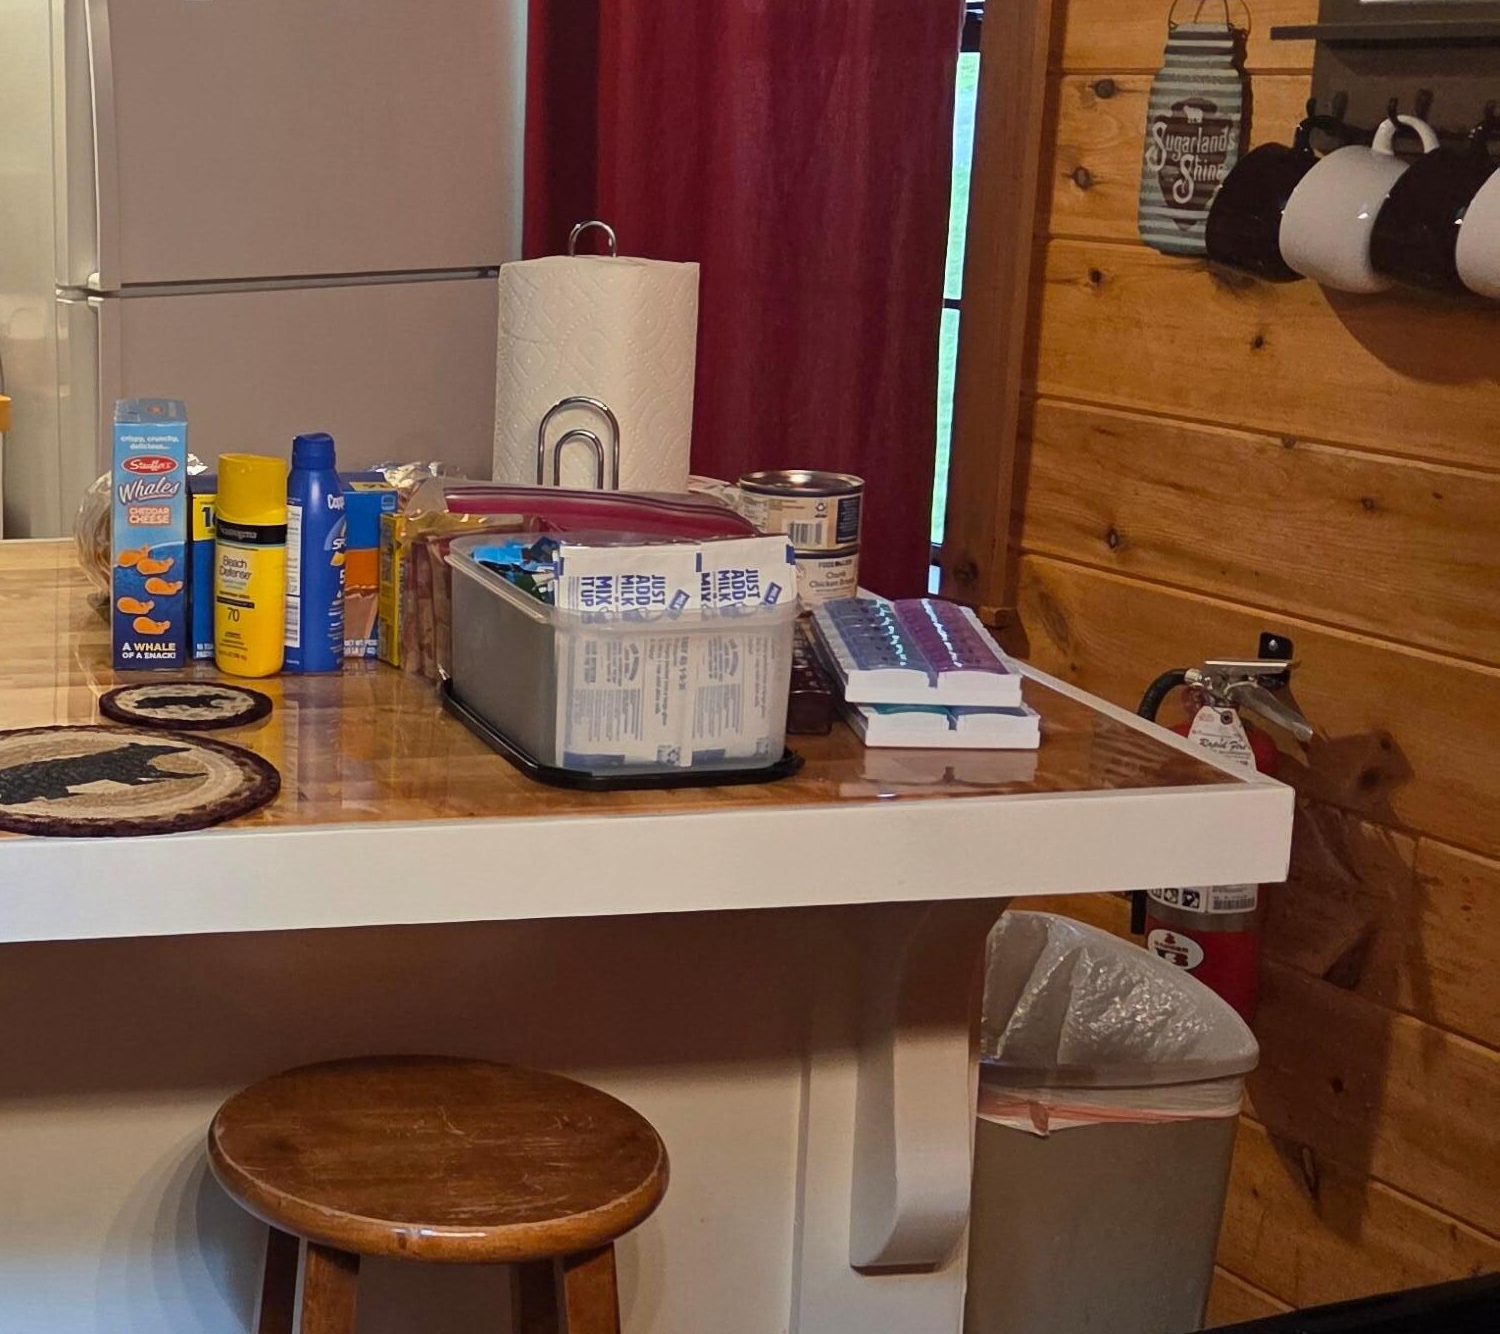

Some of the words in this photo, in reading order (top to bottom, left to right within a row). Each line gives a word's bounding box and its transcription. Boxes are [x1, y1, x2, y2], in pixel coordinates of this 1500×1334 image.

[1145, 121, 1236, 172] Sugarlands
[119, 476, 180, 504] Whales
[129, 507, 170, 515] CHEDDAR
[129, 515, 170, 524] CHEESE
[222, 555, 247, 570] Beach
[580, 576, 596, 589] IT
[596, 576, 613, 606] MIX
[621, 575, 635, 607] MILK
[636, 575, 651, 606] ADD
[651, 574, 666, 606] JUST
[717, 570, 731, 603] MILK
[731, 569, 746, 601] ADD
[745, 569, 761, 598] JUST
[580, 589, 595, 608] UP
[227, 607, 241, 622] 70
[121, 642, 132, 651] A
[133, 642, 177, 651] WHALE
